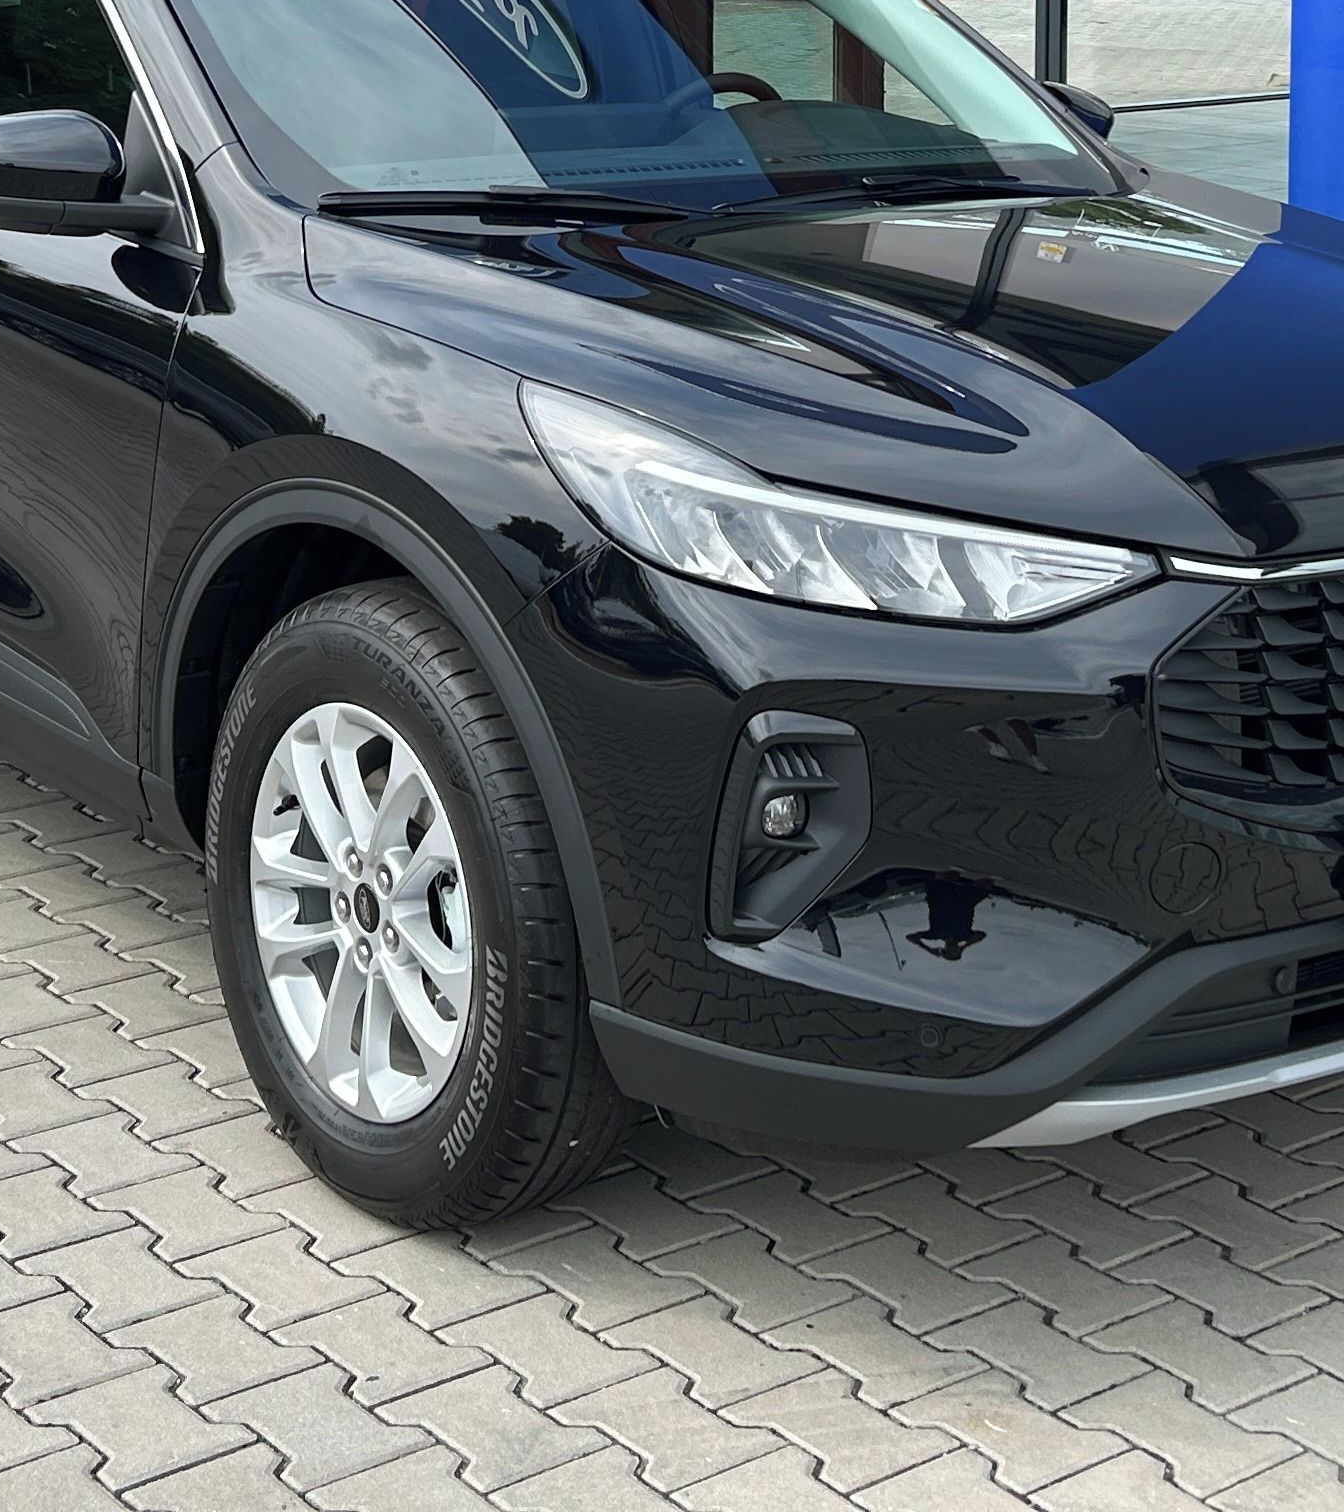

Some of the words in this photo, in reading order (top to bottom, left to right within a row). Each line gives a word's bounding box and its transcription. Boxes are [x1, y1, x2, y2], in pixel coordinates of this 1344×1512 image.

[206, 678, 256, 886] BRIDGESTONE
[352, 636, 447, 738] TURANZA
[439, 944, 508, 1171] BRIDGESTONE
